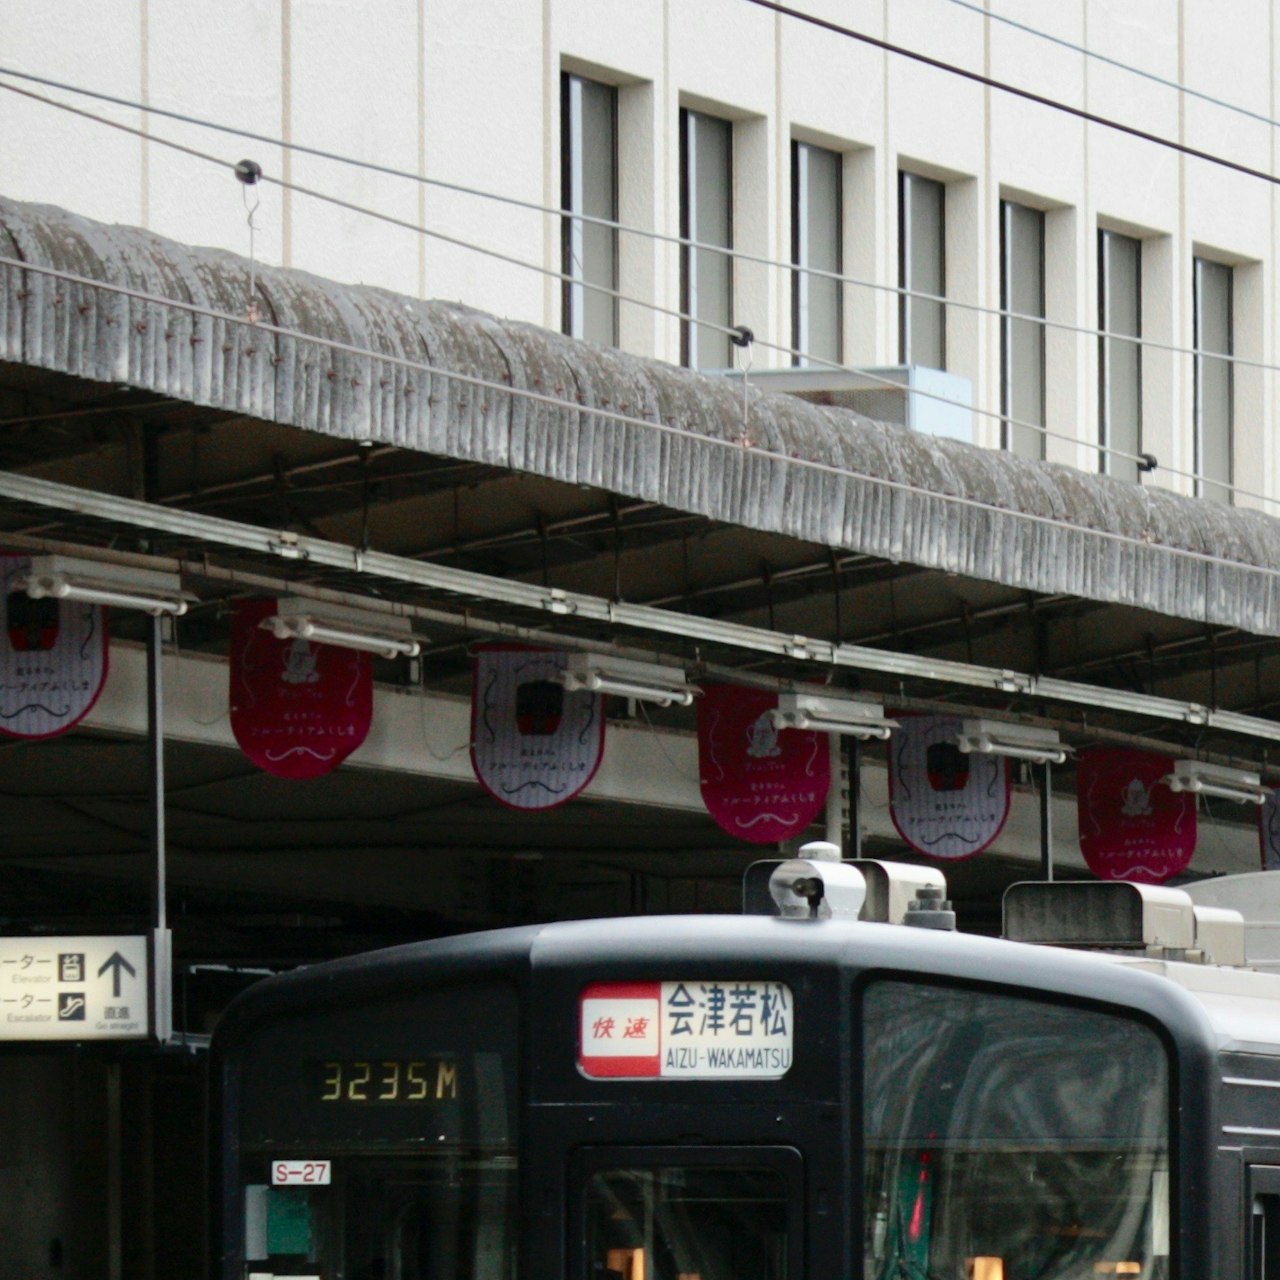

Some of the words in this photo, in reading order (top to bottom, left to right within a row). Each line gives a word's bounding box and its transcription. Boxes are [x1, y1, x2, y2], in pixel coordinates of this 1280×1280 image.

[0, 953, 52, 970] ーター
[12, 974, 52, 985] Elevator
[0, 994, 52, 1009] ーター
[668, 982, 787, 1038] 会津若松
[7, 1012, 52, 1023] Escalator
[109, 1021, 139, 1031] straight
[591, 1016, 650, 1041] 快速
[665, 1047, 791, 1071] AIZU-WAKAMATSU
[320, 1060, 459, 1102] 3235M
[275, 1162, 328, 1183] S-27
